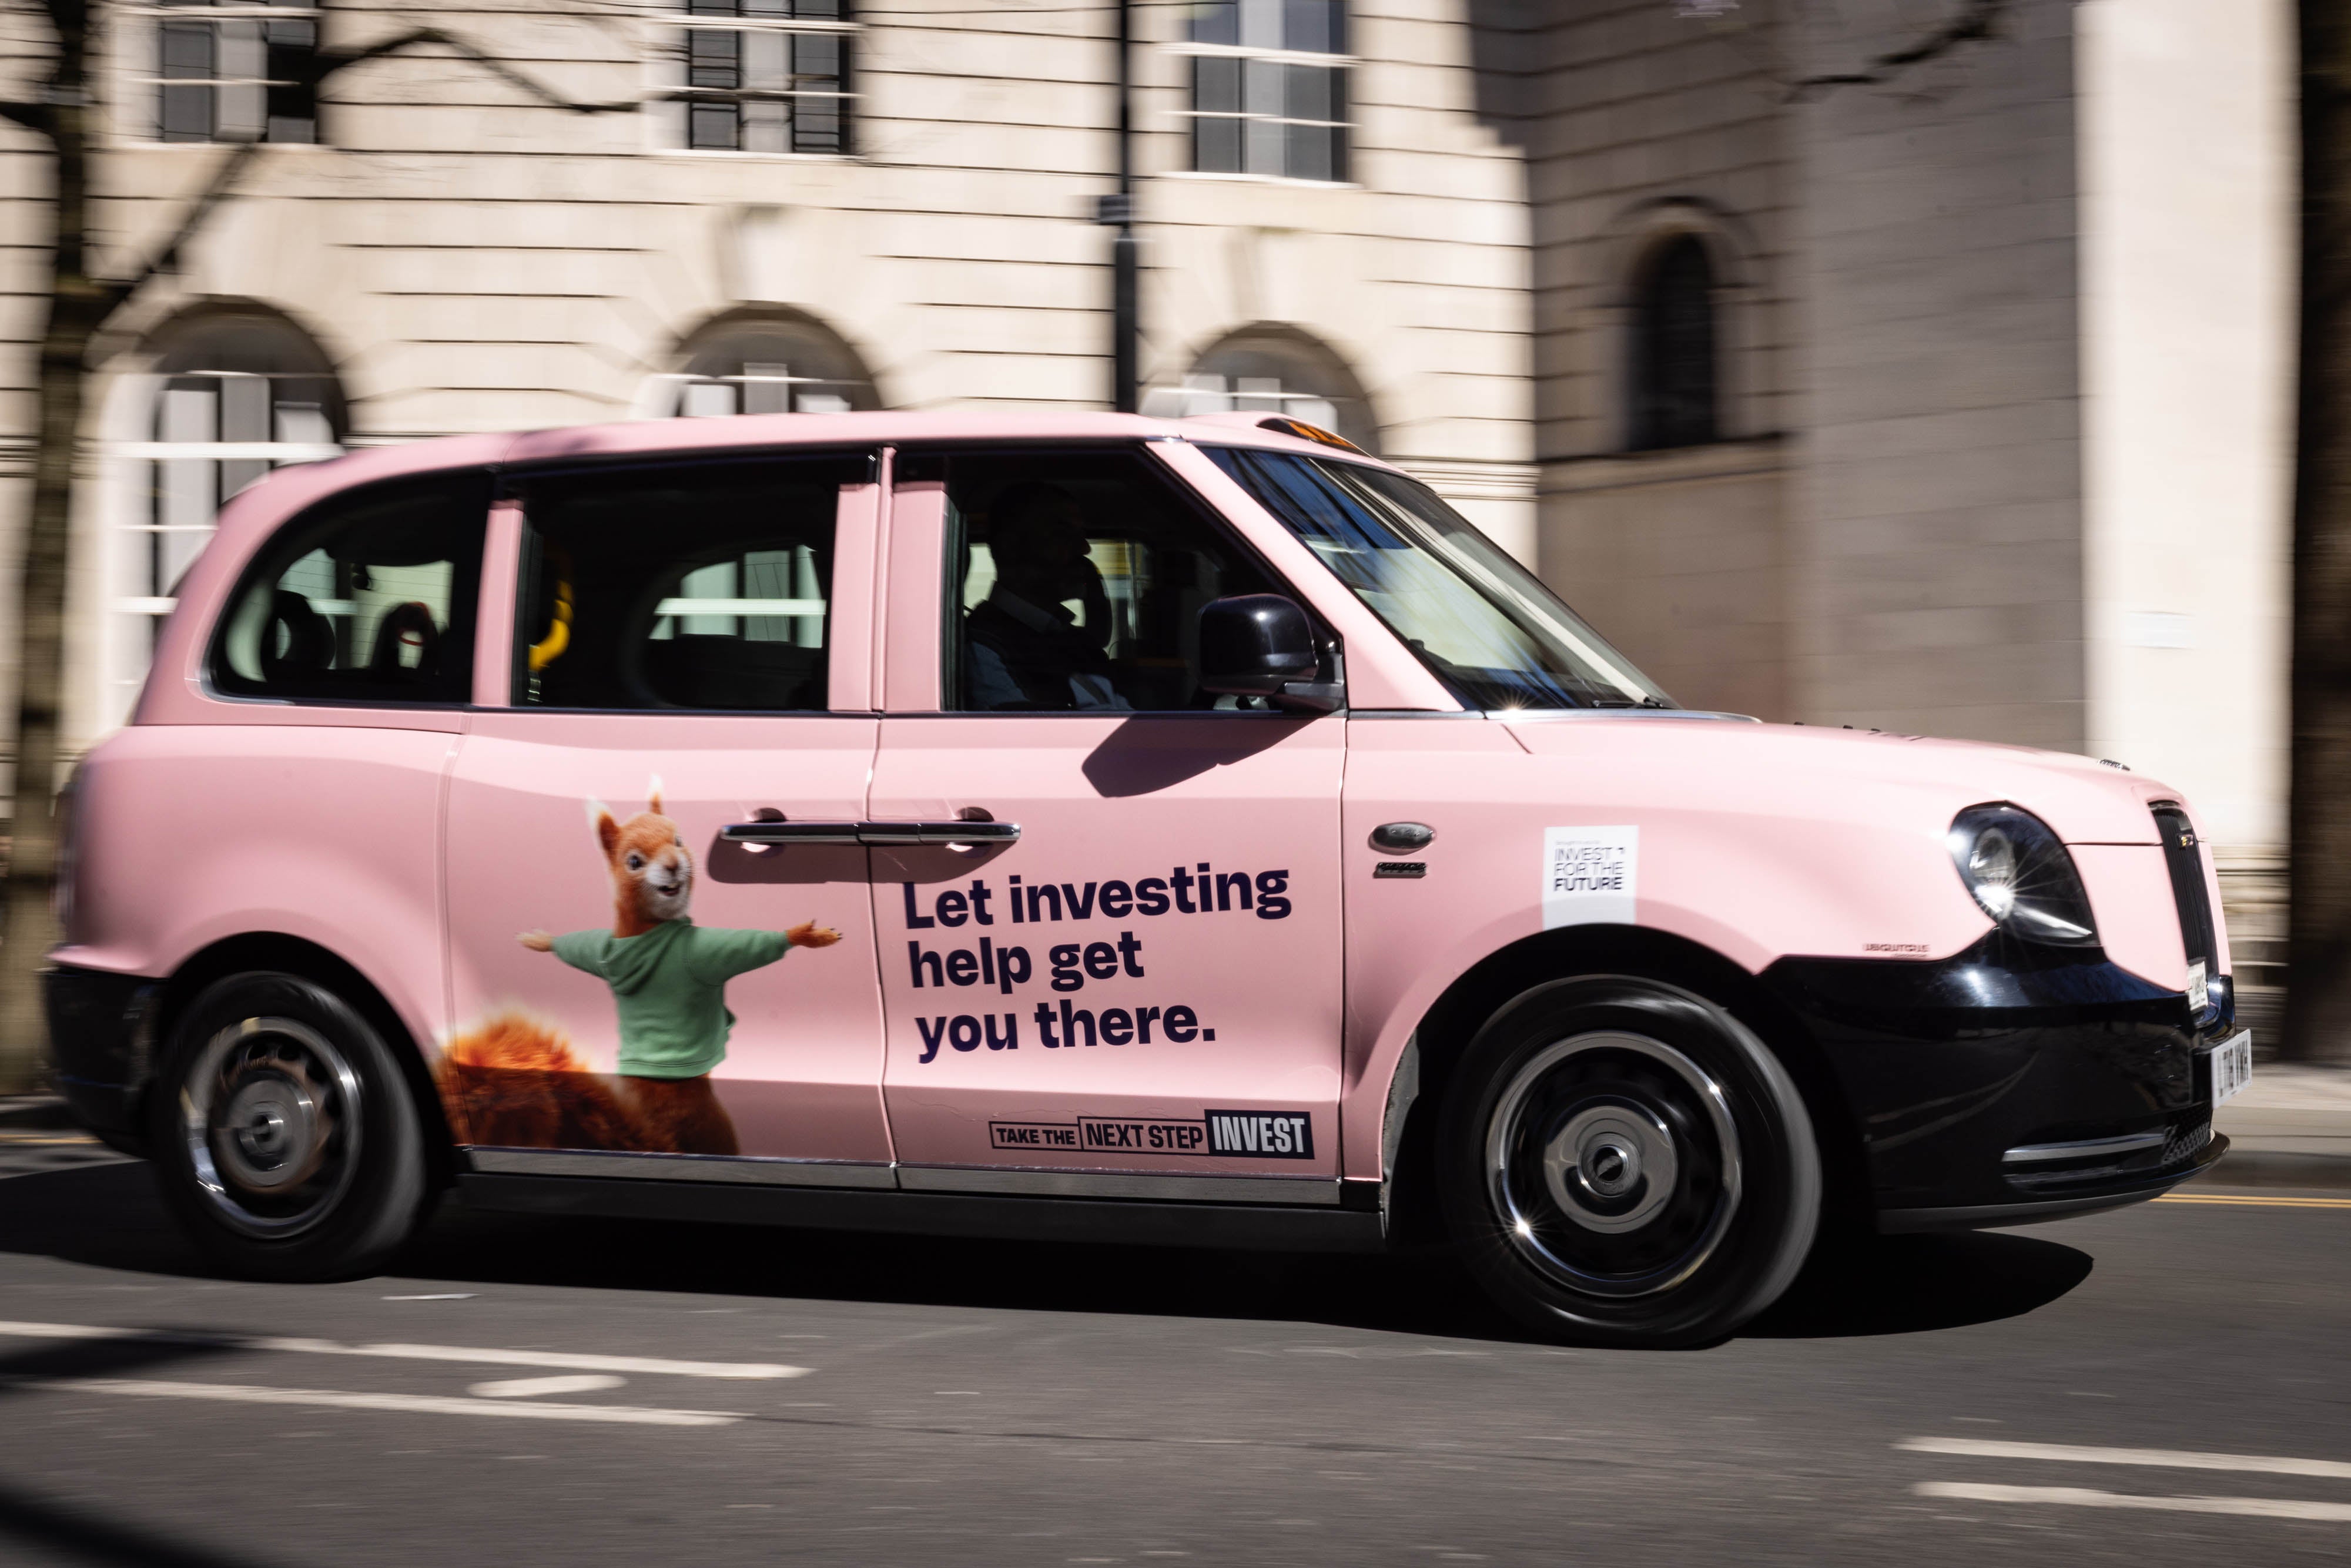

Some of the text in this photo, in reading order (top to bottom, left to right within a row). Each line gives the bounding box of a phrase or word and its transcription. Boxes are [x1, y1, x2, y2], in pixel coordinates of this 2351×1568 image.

[1554, 861, 1624, 876] FOR THE
[1555, 846, 1613, 861] INVEST
[903, 862, 1292, 930] Let investing
[1553, 876, 1623, 892] FUTURE
[907, 931, 1146, 994] help get
[915, 999, 1217, 1064] you there.
[996, 1116, 1305, 1153] TAKE THE NEXT STEP INVEST
